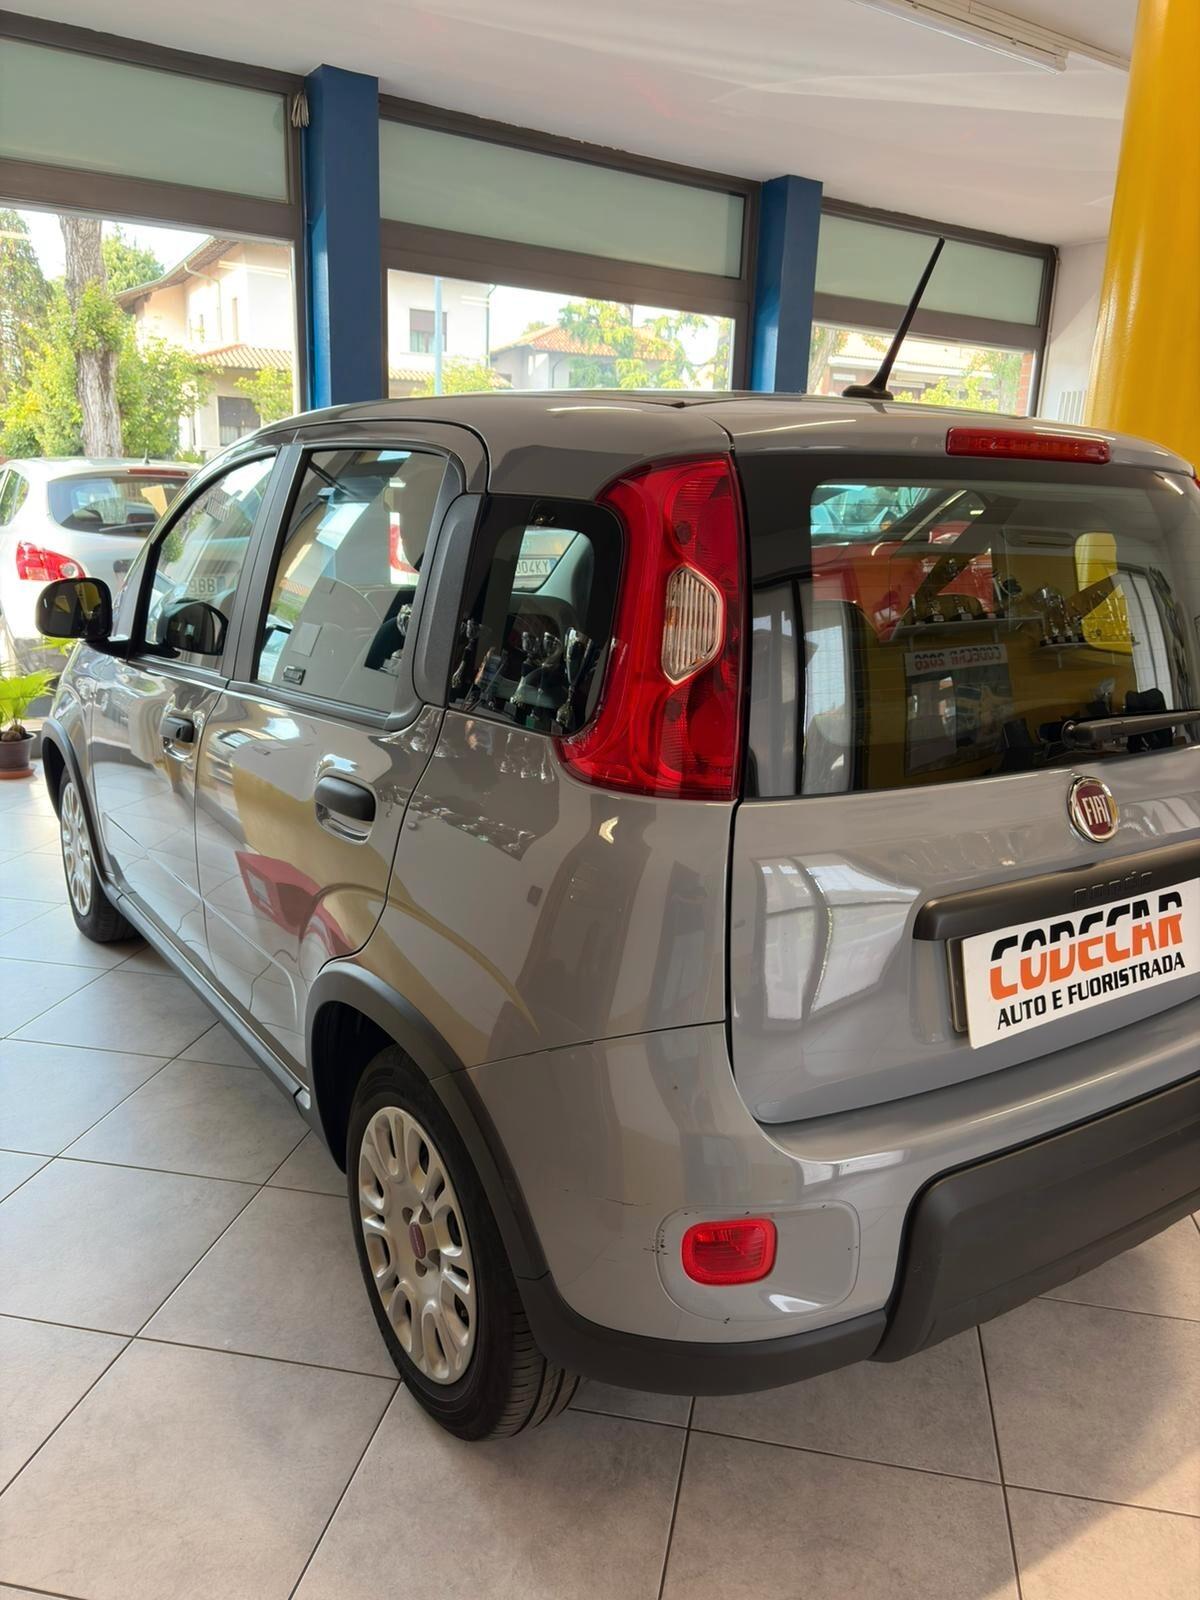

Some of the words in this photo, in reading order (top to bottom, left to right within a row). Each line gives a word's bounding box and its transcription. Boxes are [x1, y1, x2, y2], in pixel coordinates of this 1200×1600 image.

[1081, 794, 1111, 826] FIAT
[990, 891, 1183, 1000] CODECAR
[997, 994, 1047, 1030] AUTO
[1053, 989, 1063, 1010] E
[1068, 952, 1186, 1005] FUORISTRADA
